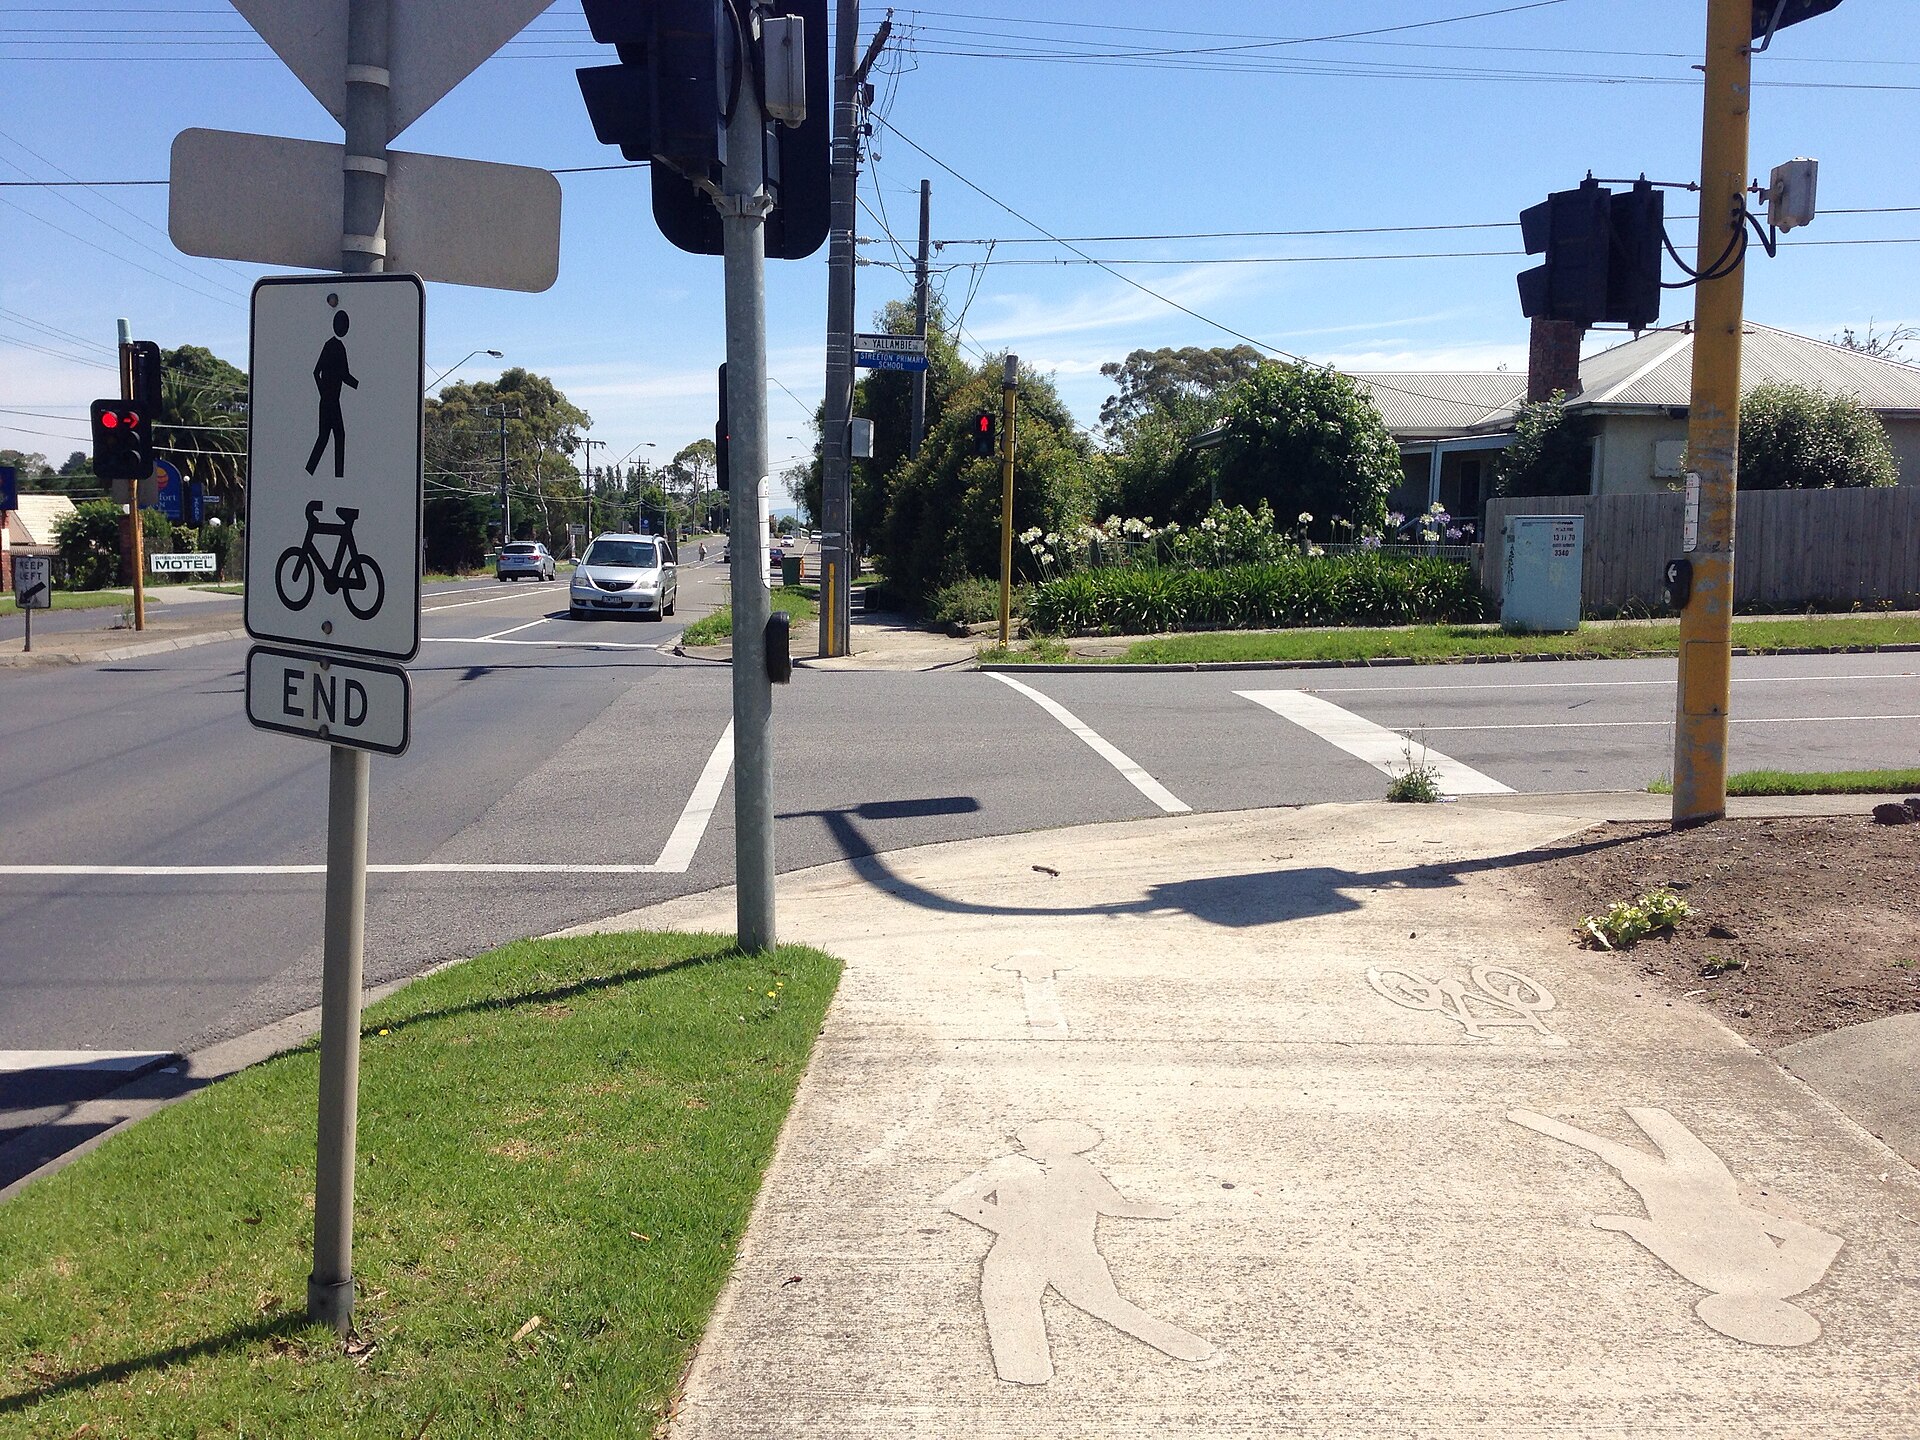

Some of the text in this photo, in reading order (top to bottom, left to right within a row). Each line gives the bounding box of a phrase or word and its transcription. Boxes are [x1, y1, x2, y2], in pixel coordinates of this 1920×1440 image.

[872, 339, 912, 350] YALLAMBIE
[860, 352, 925, 363] STREETON PRIMARY
[878, 360, 905, 370] SCHOOL
[19, 560, 44, 570] KEEP
[155, 560, 213, 570] MOTEL
[19, 571, 42, 581] LEFT
[283, 668, 368, 727] END
